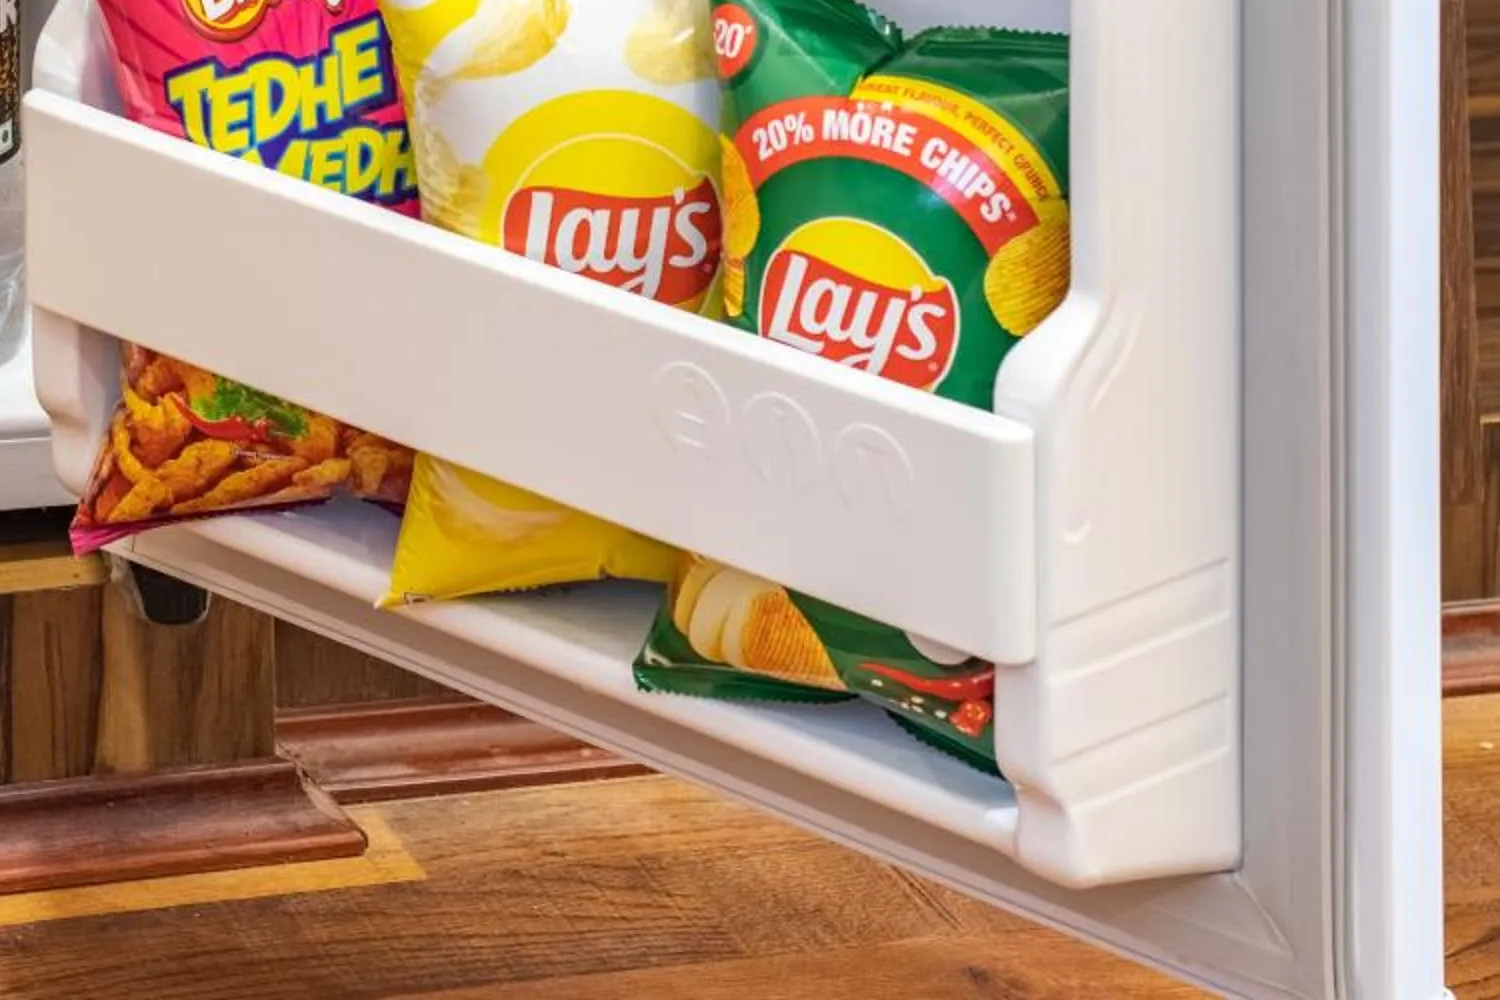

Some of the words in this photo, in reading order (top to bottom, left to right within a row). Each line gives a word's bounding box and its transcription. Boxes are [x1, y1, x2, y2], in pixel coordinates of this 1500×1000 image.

[167, 17, 383, 153] TEDHE
[240, 126, 419, 195] EDH
[752, 112, 815, 162] 20%
[822, 108, 918, 157] MORE
[919, 136, 1013, 224] CHIPS
[526, 185, 711, 300] Lay's
[767, 252, 947, 378] Lay's
